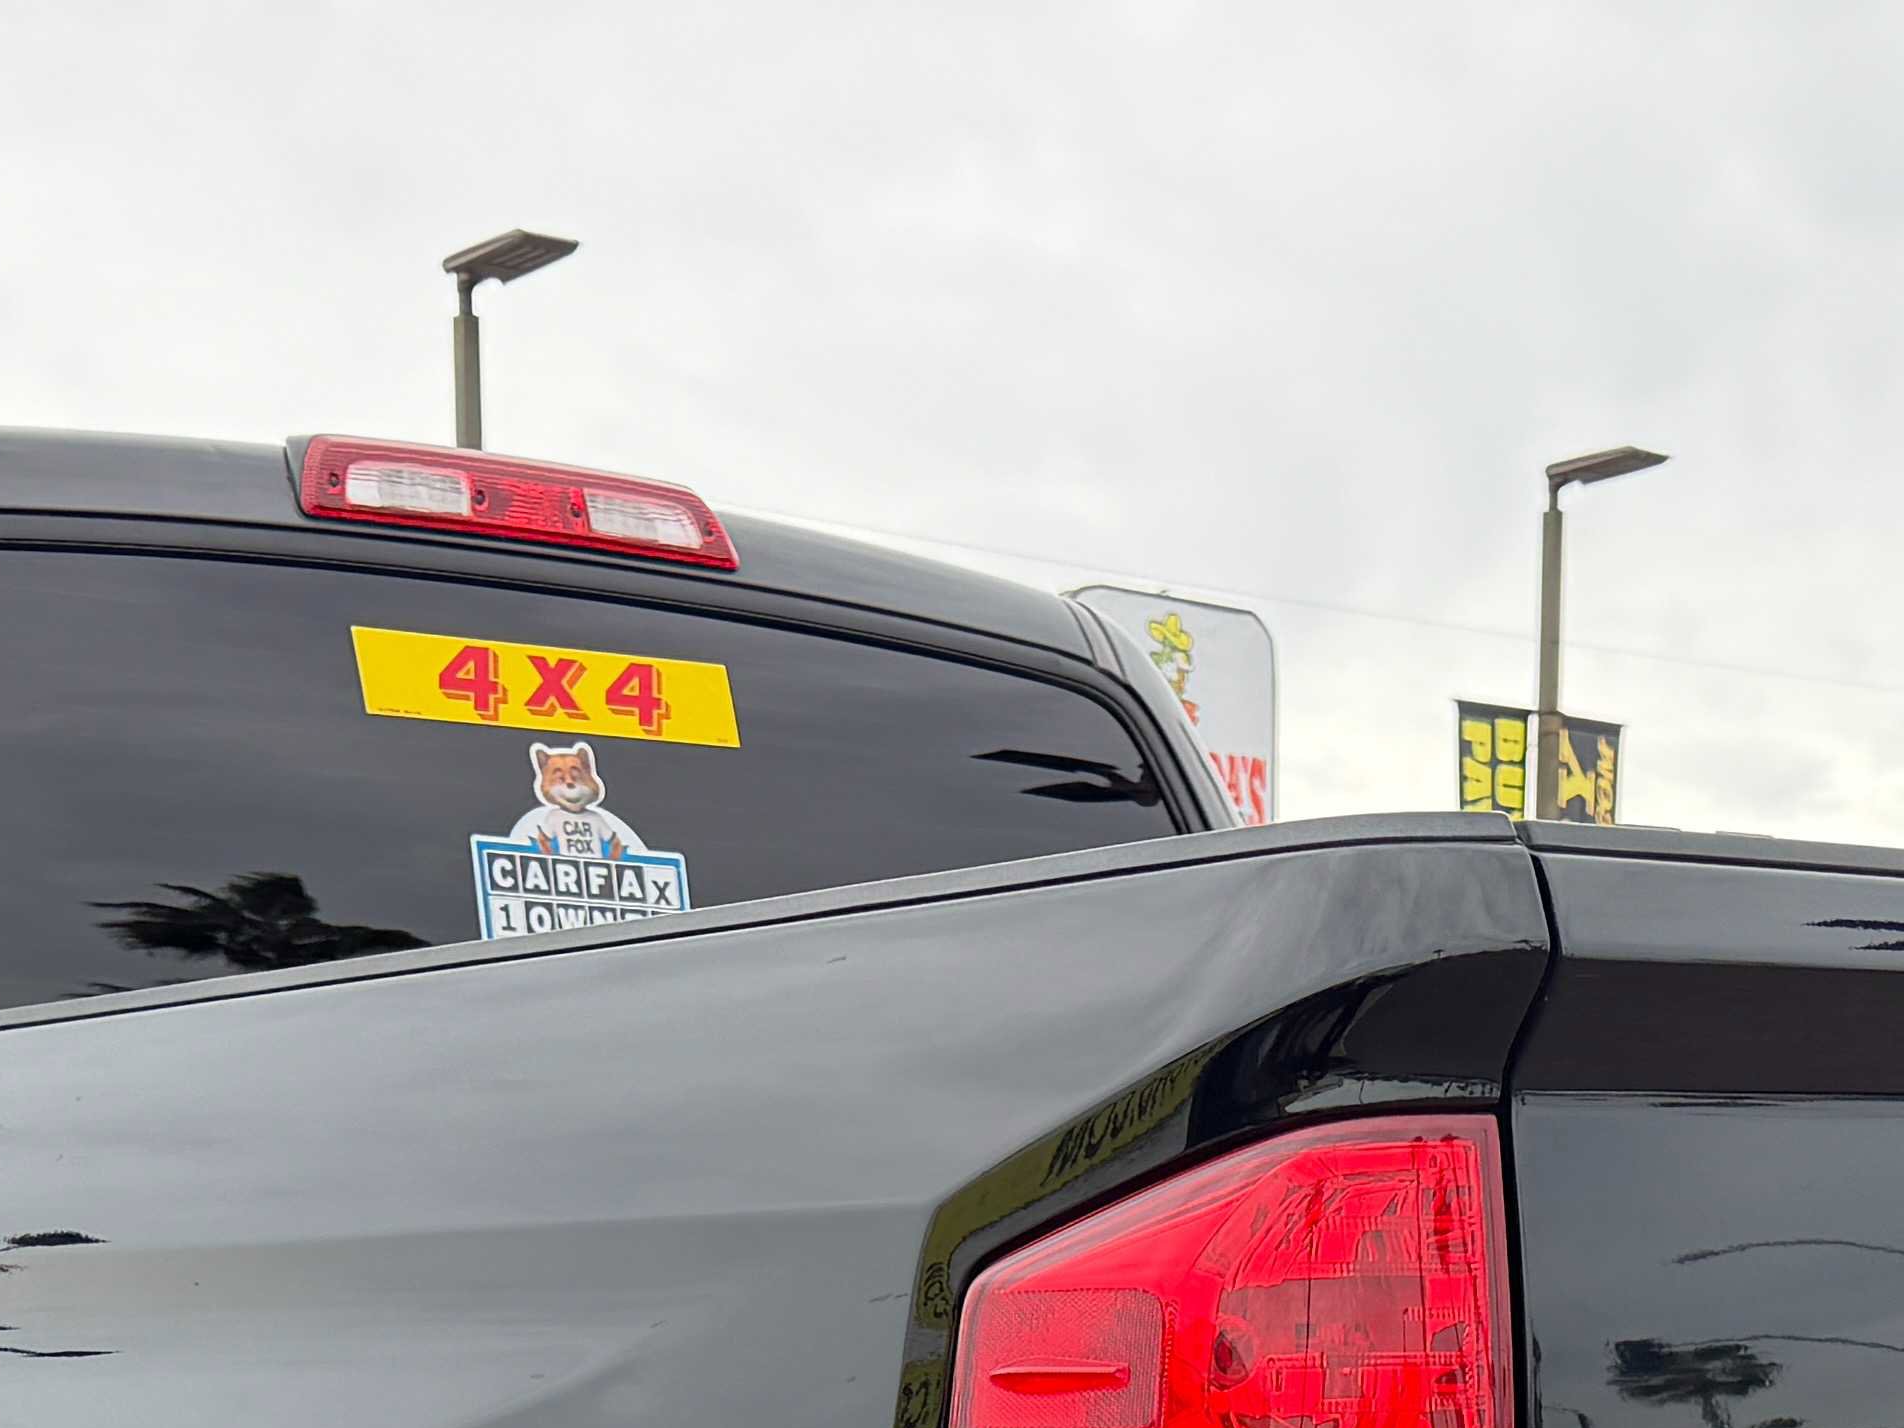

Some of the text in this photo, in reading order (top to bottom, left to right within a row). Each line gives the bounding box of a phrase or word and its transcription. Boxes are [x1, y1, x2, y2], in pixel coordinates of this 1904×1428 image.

[563, 821, 592, 837] CAR
[567, 838, 594, 854] FOX
[492, 857, 673, 906] CARFAX
[499, 903, 517, 931] 1
